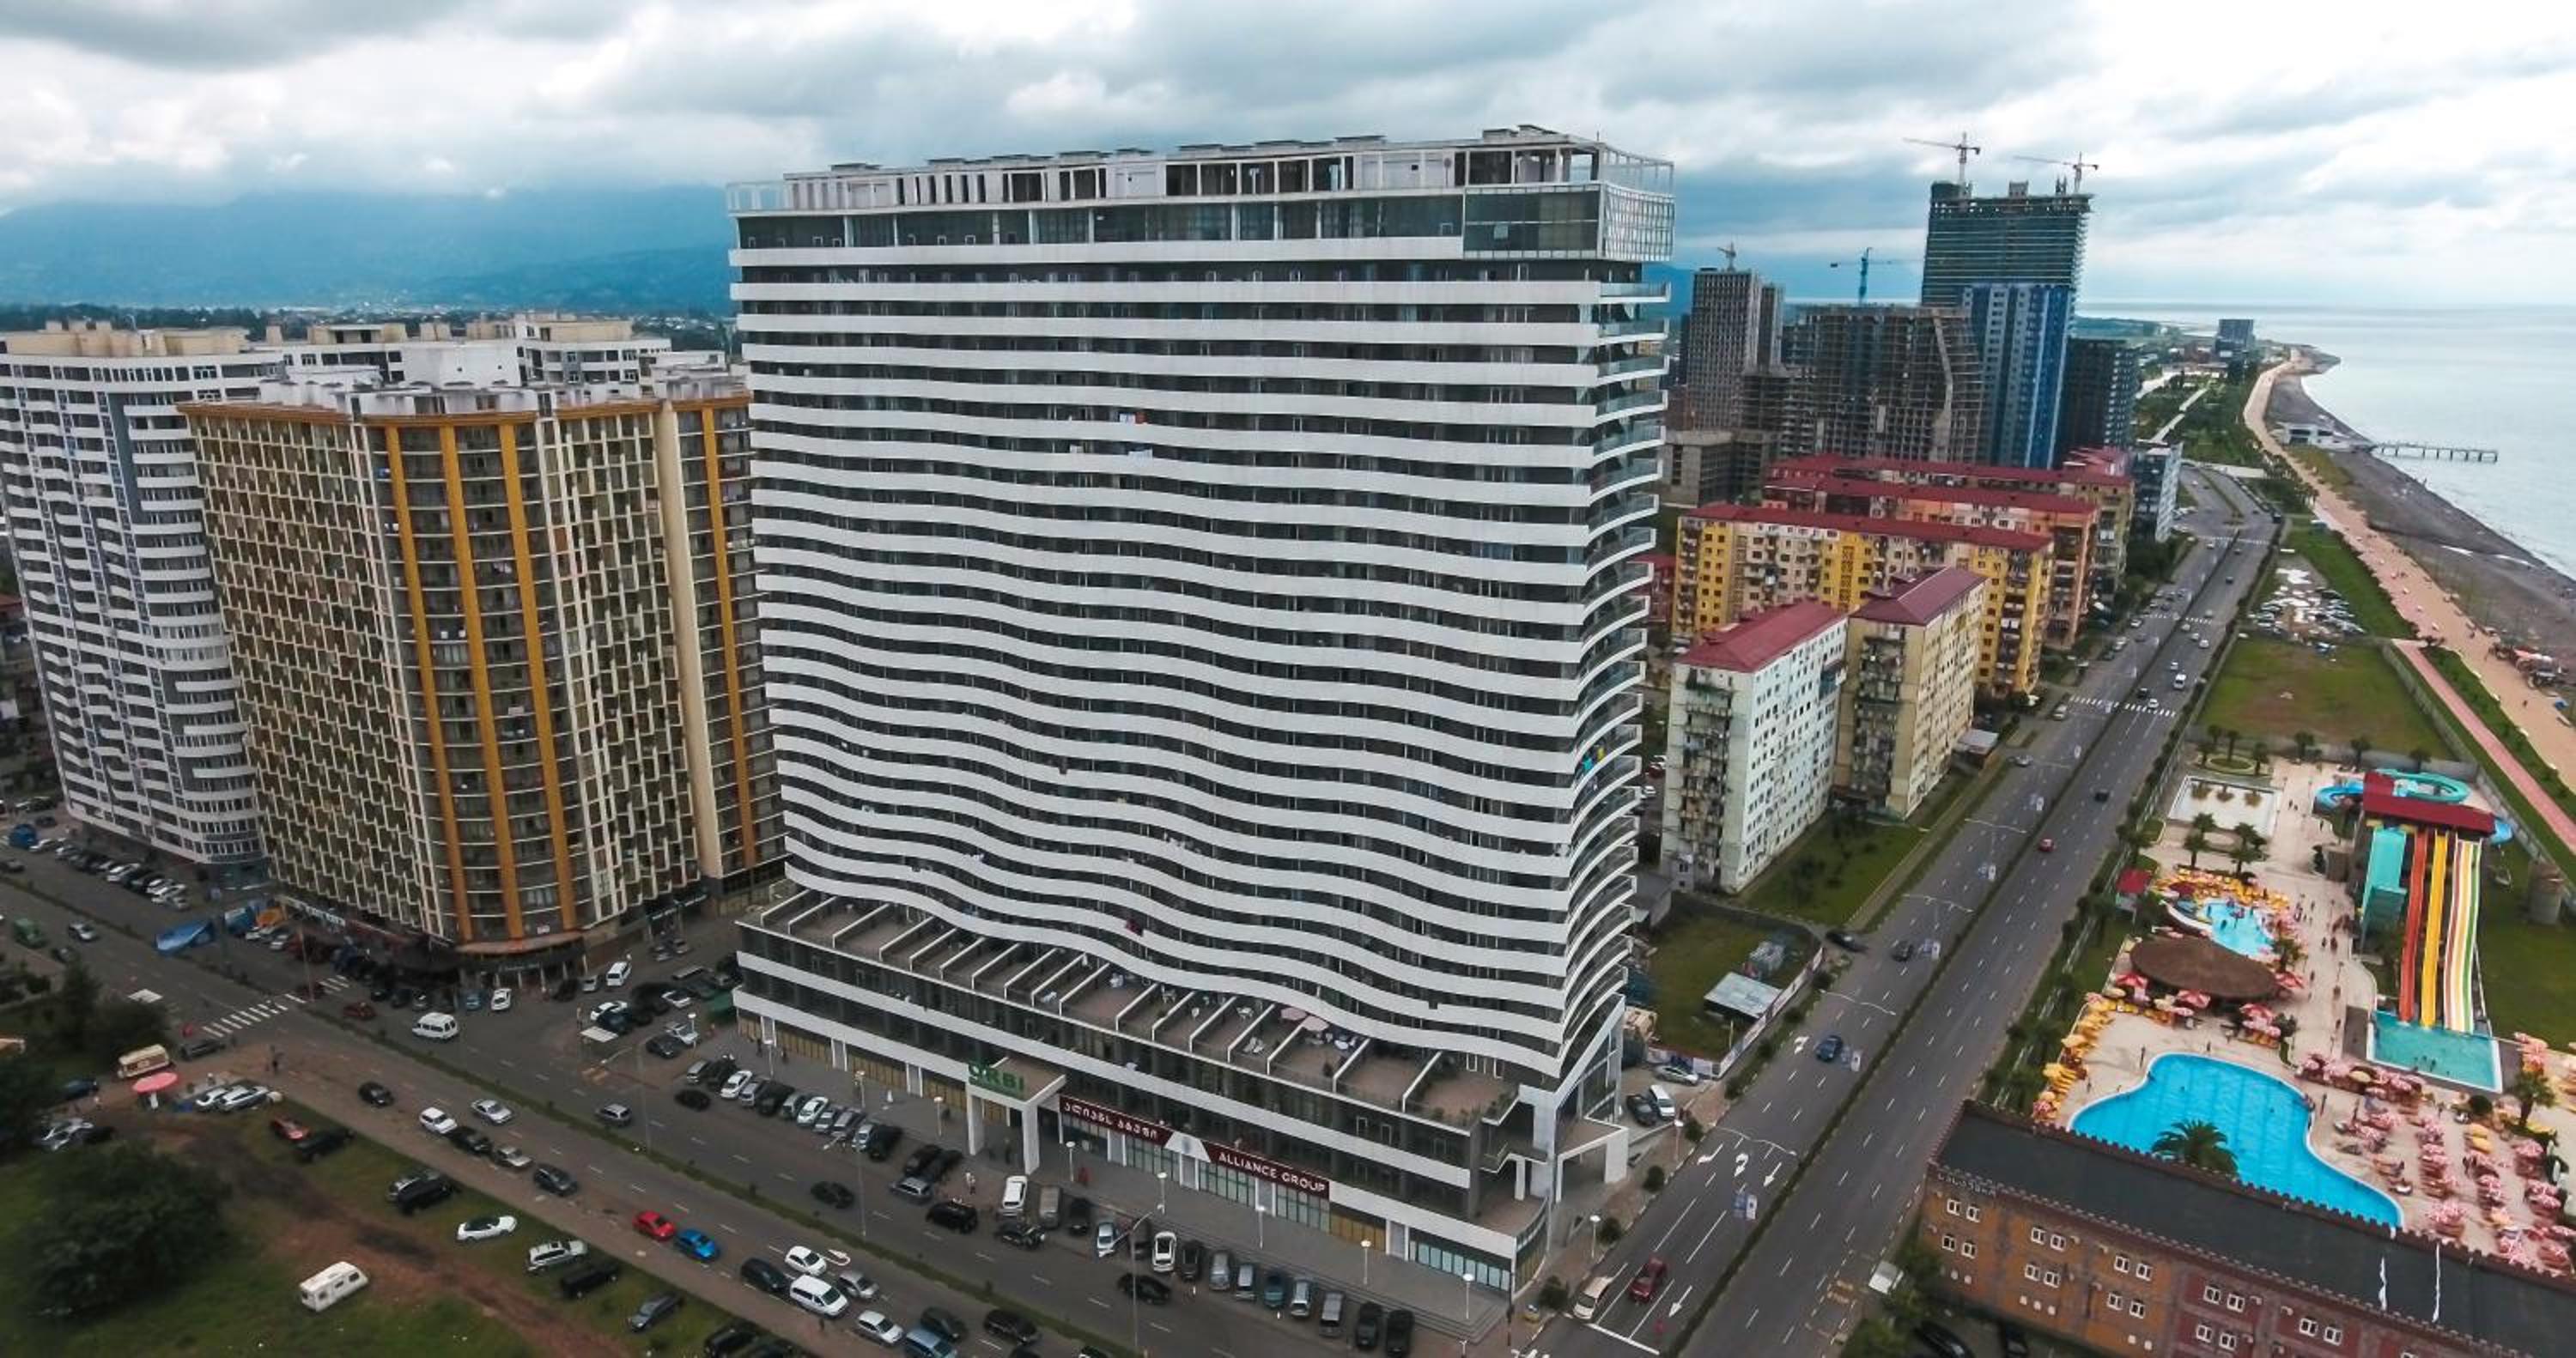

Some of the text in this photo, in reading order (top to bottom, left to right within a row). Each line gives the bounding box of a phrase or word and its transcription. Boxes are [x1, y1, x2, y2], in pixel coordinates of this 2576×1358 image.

[968, 1062, 1025, 1094] ORBI
[1218, 1151, 1326, 1192] ALLIANCE GROUP
